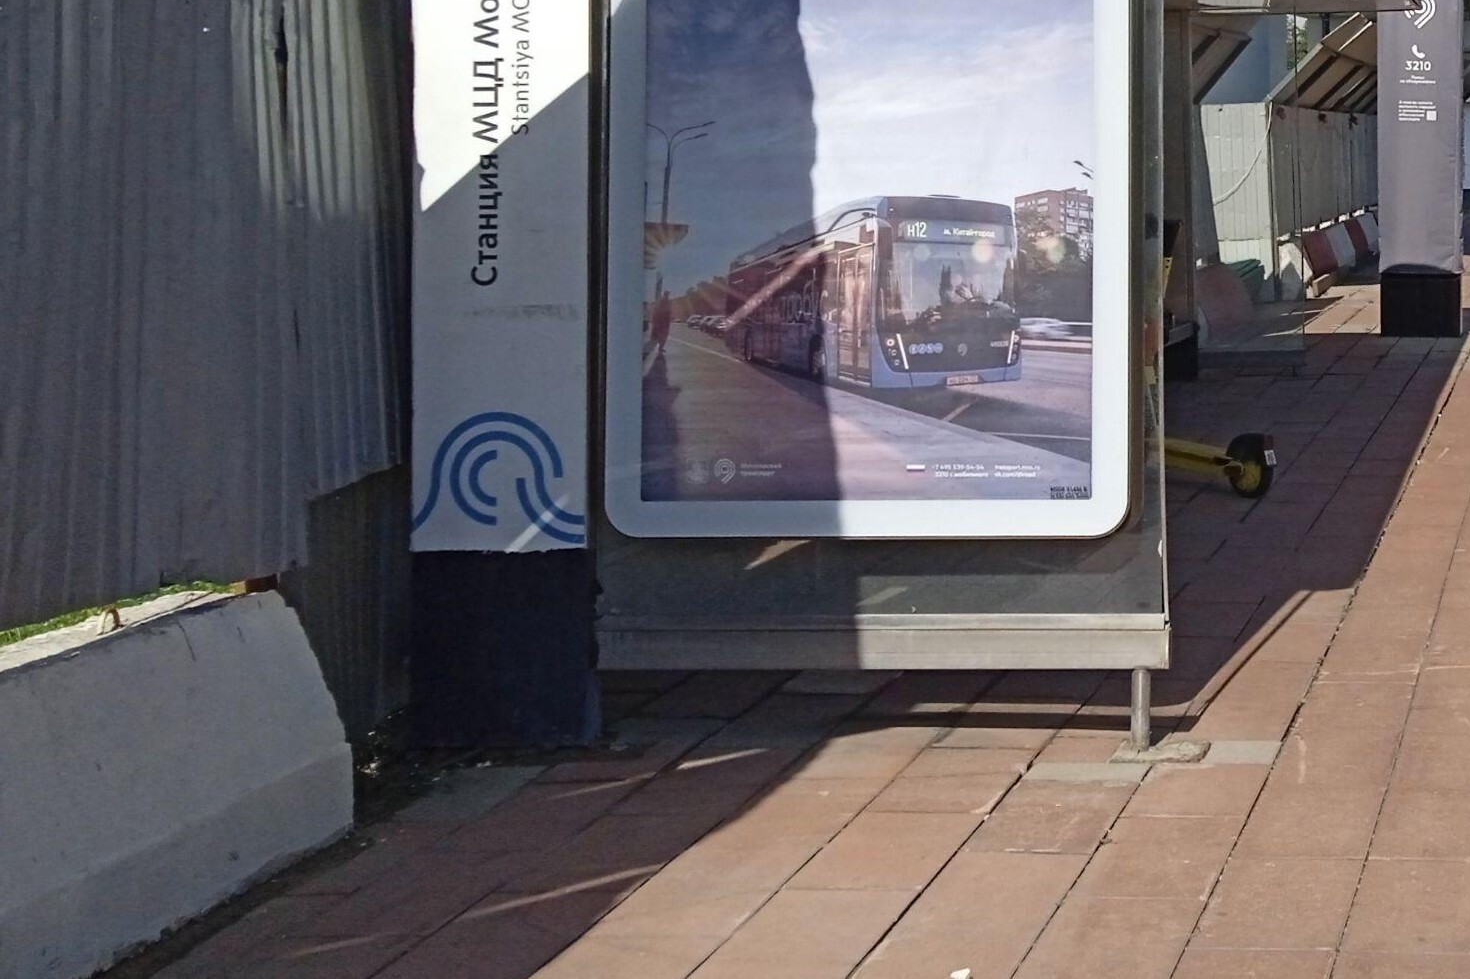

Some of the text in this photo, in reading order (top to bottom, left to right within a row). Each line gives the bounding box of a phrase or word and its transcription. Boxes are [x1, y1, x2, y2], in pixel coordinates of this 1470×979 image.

[471, 57, 504, 144] МЦД
[510, 38, 534, 136] Stantsiya
[1405, 60, 1432, 71] 3210
[470, 153, 503, 287] Станция
